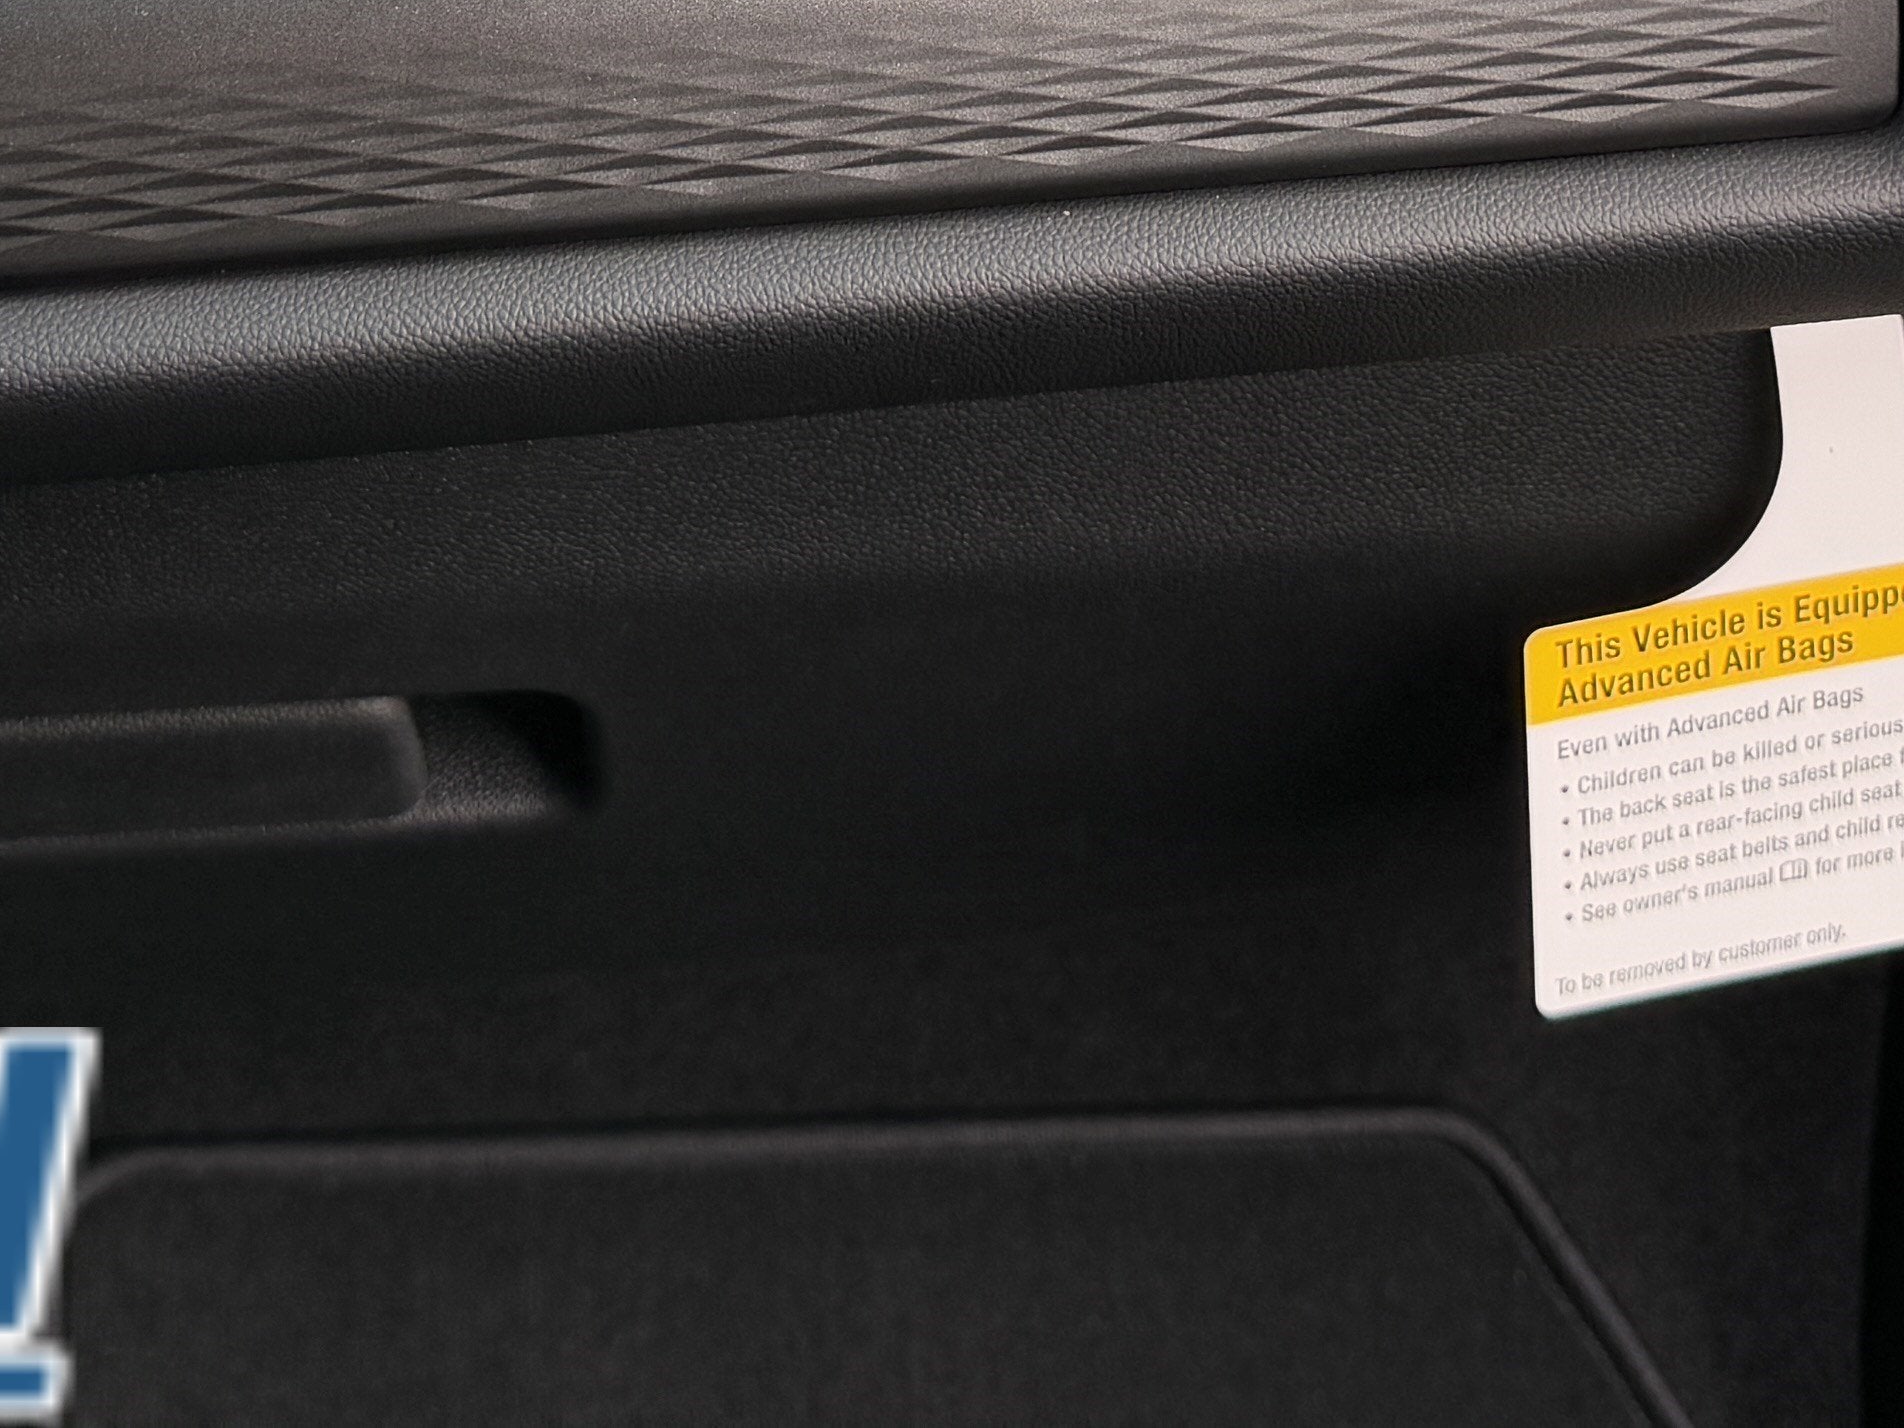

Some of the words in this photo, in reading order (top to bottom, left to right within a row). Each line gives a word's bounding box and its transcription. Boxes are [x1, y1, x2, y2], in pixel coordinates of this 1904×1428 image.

[1554, 632, 1621, 669] This
[1631, 609, 1746, 653] Vehicle
[1756, 601, 1782, 630] is
[1557, 649, 1711, 708] Advanced
[1721, 641, 1766, 675] Air
[1777, 630, 1854, 664] Bags
[1557, 735, 1608, 760] Even
[1614, 722, 1660, 748] with
[1666, 699, 1770, 738] Advanced
[1776, 694, 1806, 718] Air
[1813, 687, 1864, 710] Bags
[1577, 764, 1662, 795] Children
[1668, 756, 1706, 777] can
[1711, 749, 1736, 768] be
[1743, 734, 1798, 763] killed
[1804, 733, 1826, 751] or
[1577, 806, 1614, 827] The
[1619, 793, 1667, 819] back
[1672, 783, 1714, 809] seat
[1719, 780, 1736, 800] is
[1741, 774, 1772, 796] the
[1778, 759, 1838, 788] safest
[1841, 752, 1893, 780] place
[1579, 833, 1636, 860] Never
[1641, 824, 1674, 851] put
[1678, 823, 1691, 839] a
[1696, 801, 1803, 836] rear-facing
[1808, 787, 1855, 813] child
[1860, 779, 1902, 804] seat
[1579, 863, 1650, 891] Always
[1655, 855, 1690, 876] use
[1695, 842, 1738, 868] seat
[1742, 834, 1790, 858] belts
[1794, 824, 1830, 849] and
[1835, 814, 1881, 840] child
[1581, 902, 1617, 923] See
[1704, 866, 1774, 898] manual
[1815, 856, 1841, 877] for
[1846, 847, 1894, 871] more
[1555, 976, 1578, 997] To
[1581, 972, 1604, 991] be
[1609, 952, 1688, 986] removed
[1692, 949, 1714, 970] by
[1718, 932, 1802, 964] customer
